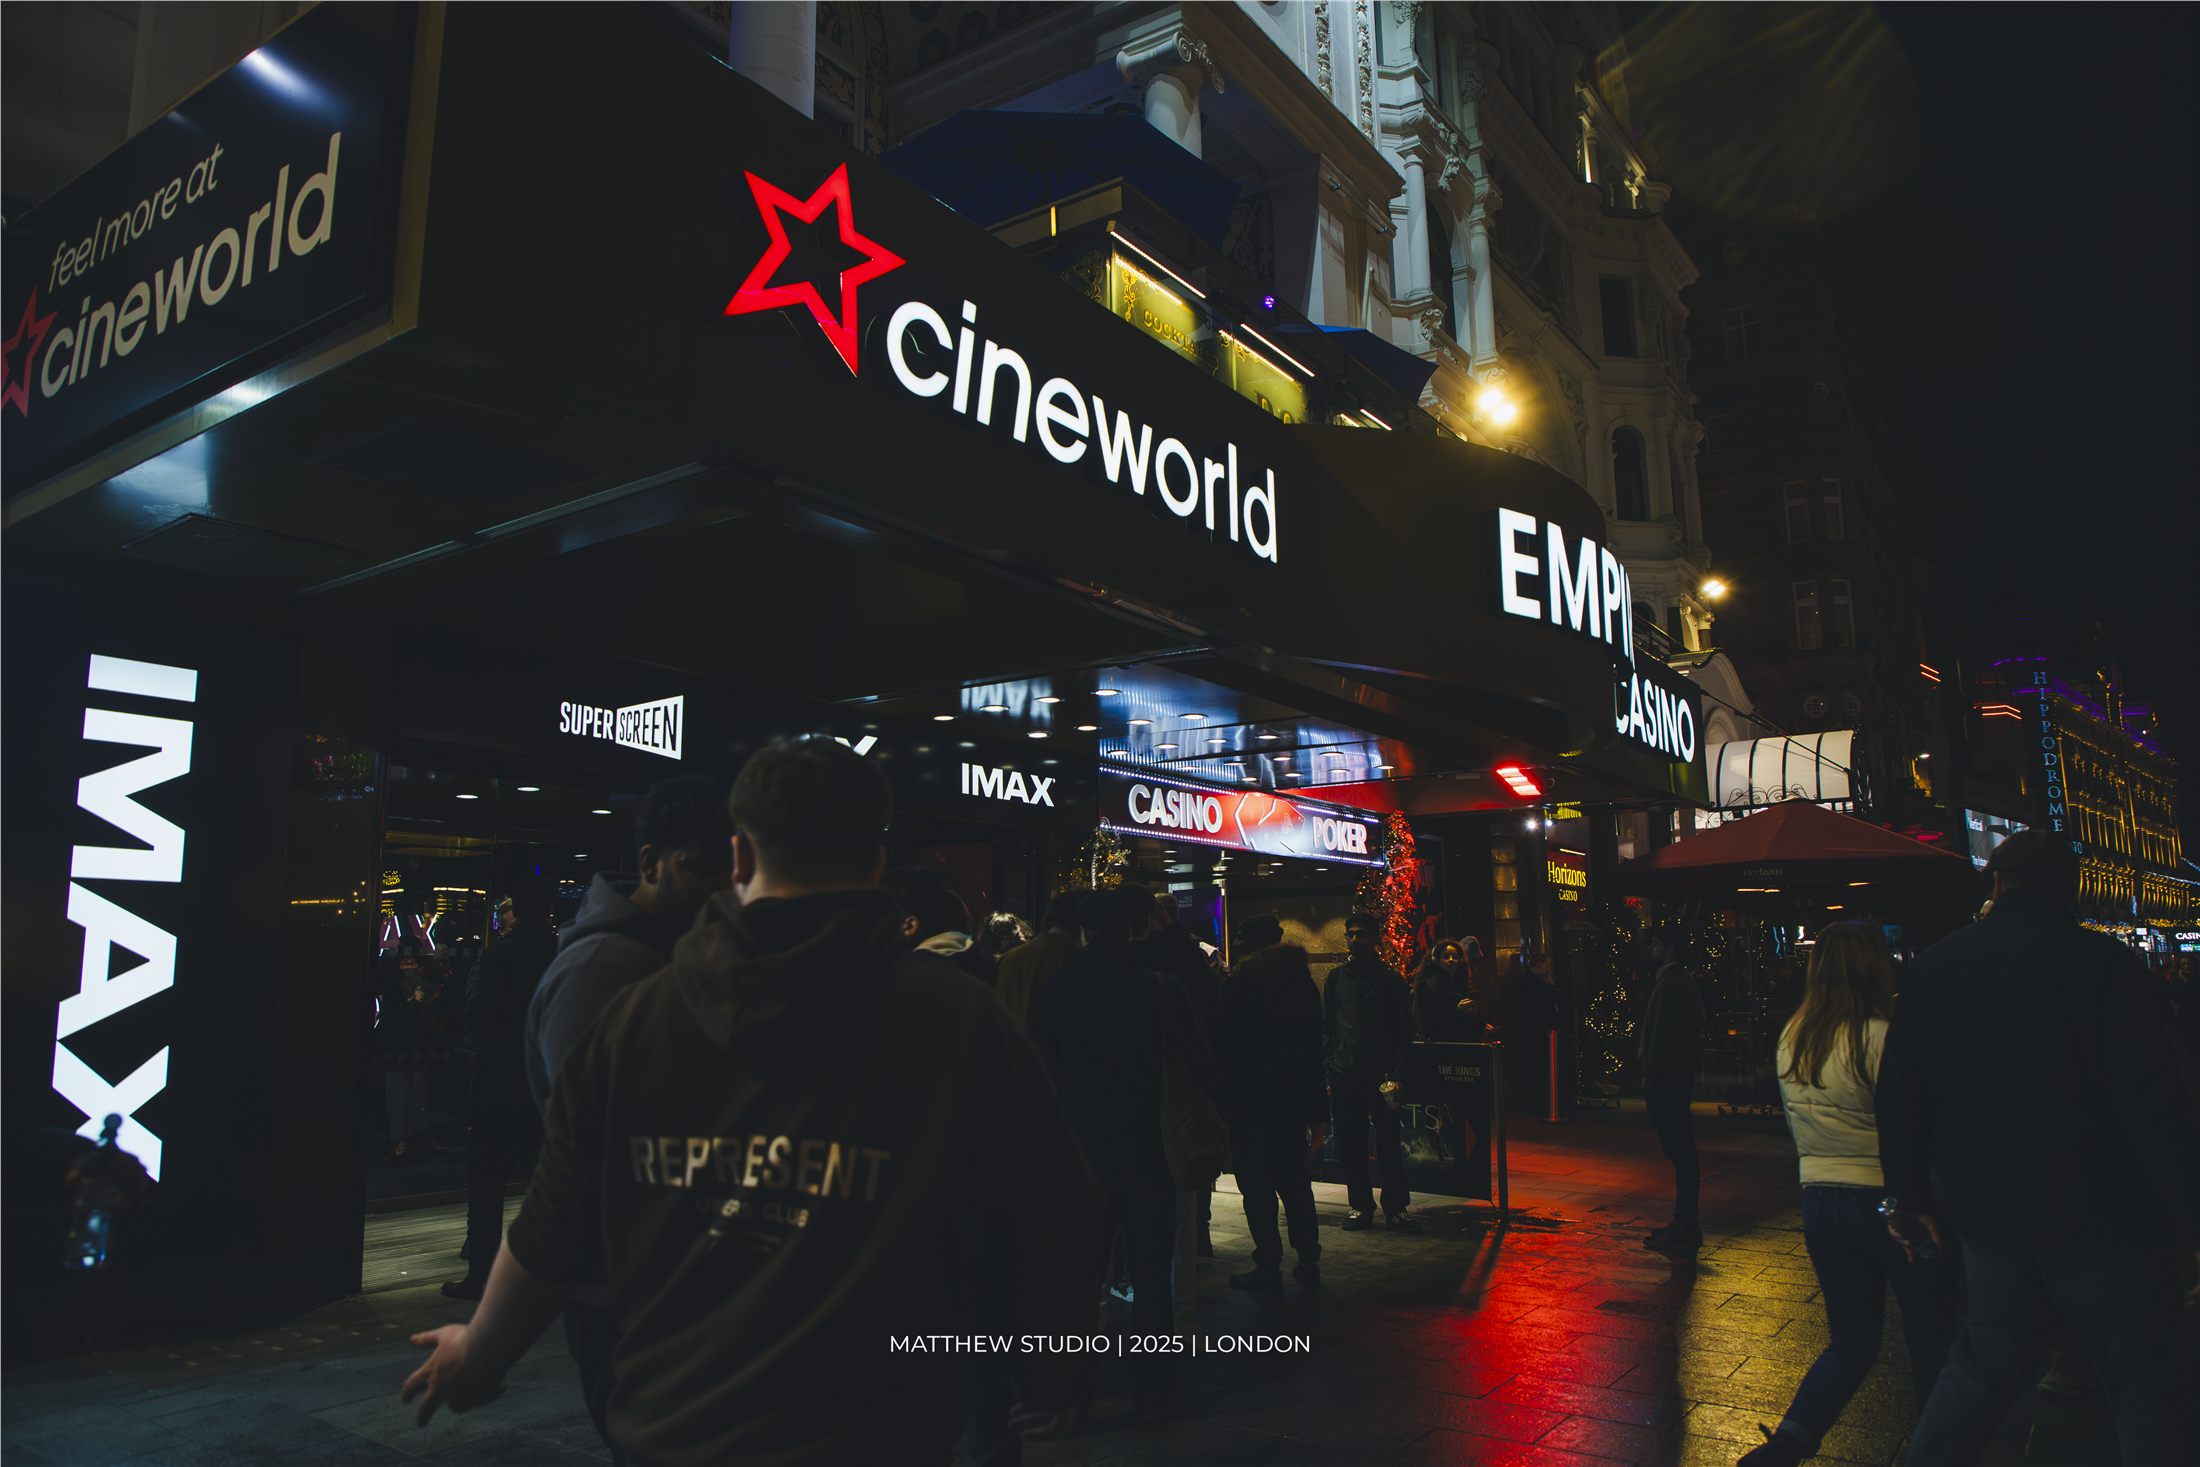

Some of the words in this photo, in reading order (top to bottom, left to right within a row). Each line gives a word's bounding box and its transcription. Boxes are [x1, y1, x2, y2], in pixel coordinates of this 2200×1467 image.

[49, 240, 103, 295] feel
[101, 177, 182, 262] more
[185, 143, 225, 205] at
[41, 131, 342, 398] cineworld
[886, 298, 1279, 564] cineworld
[559, 701, 614, 741] SUPER
[619, 702, 679, 752] SCREEN
[2033, 671, 2064, 832] HIPPODROME
[961, 762, 1056, 807] IMAX
[1128, 783, 1224, 834] CASINO
[1312, 816, 1369, 855] POKER
[1547, 860, 1588, 888] Horizons
[1558, 889, 1578, 902] CASINO
[51, 653, 199, 1184] IMAX
[628, 1133, 893, 1202] REPRESENT
